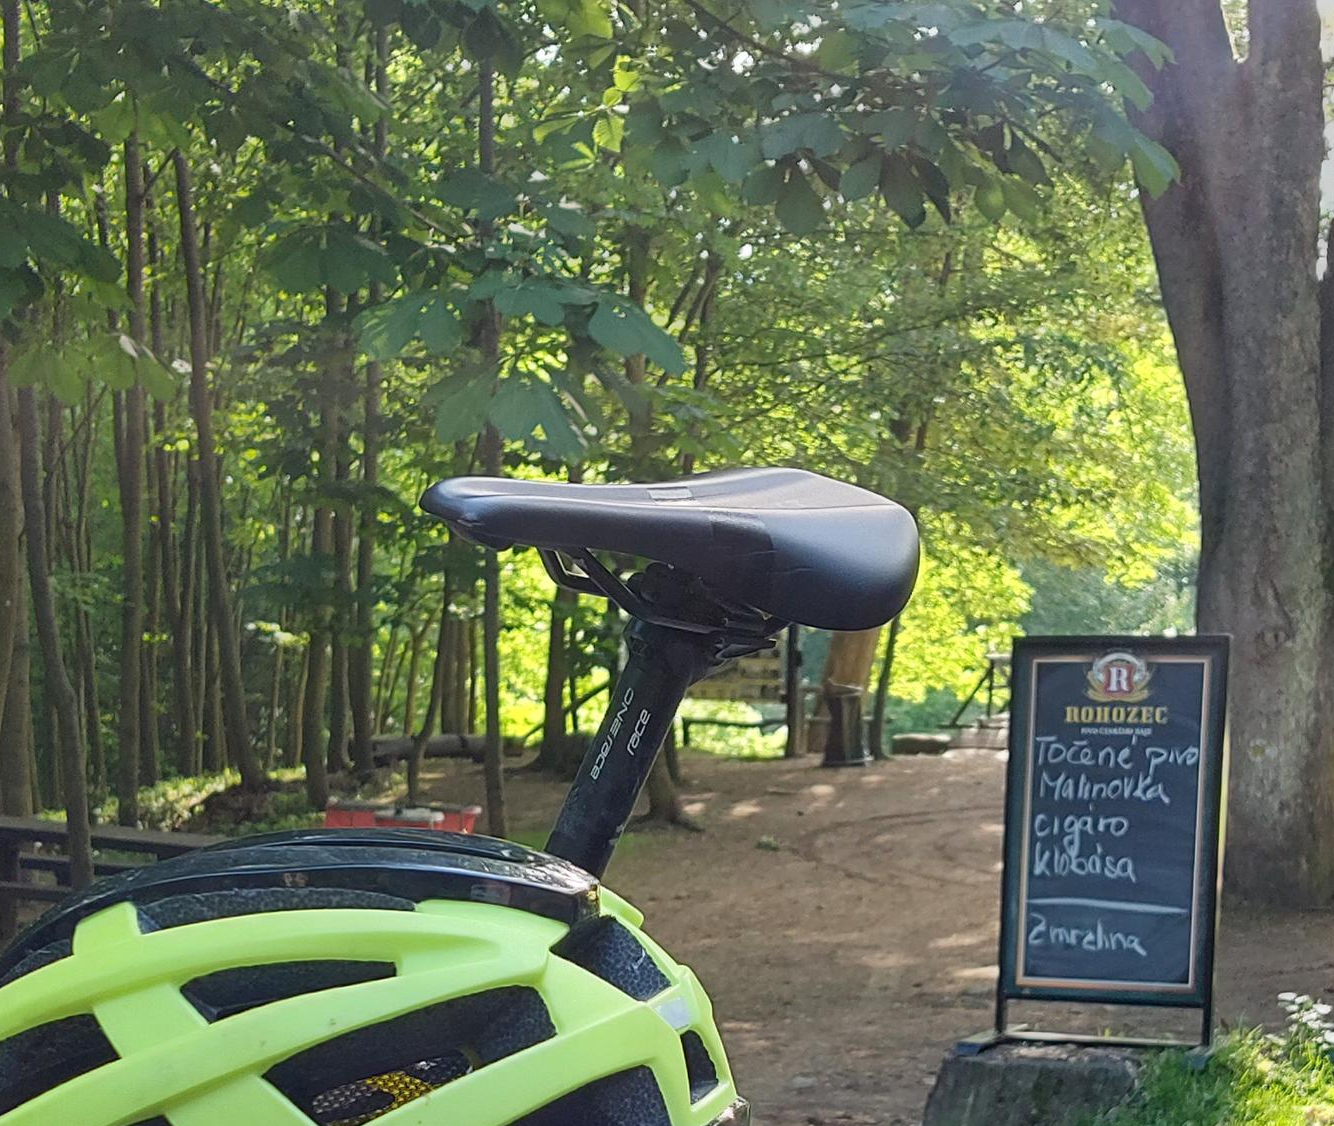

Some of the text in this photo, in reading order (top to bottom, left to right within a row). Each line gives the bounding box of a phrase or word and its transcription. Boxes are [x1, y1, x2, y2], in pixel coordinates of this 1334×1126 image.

[1107, 667, 1130, 691] R
[627, 708, 651, 755] race
[1065, 706, 1168, 724] ROHOZEC
[1036, 734, 1199, 777] Točené pivo
[1039, 770, 1170, 804] Malinovka
